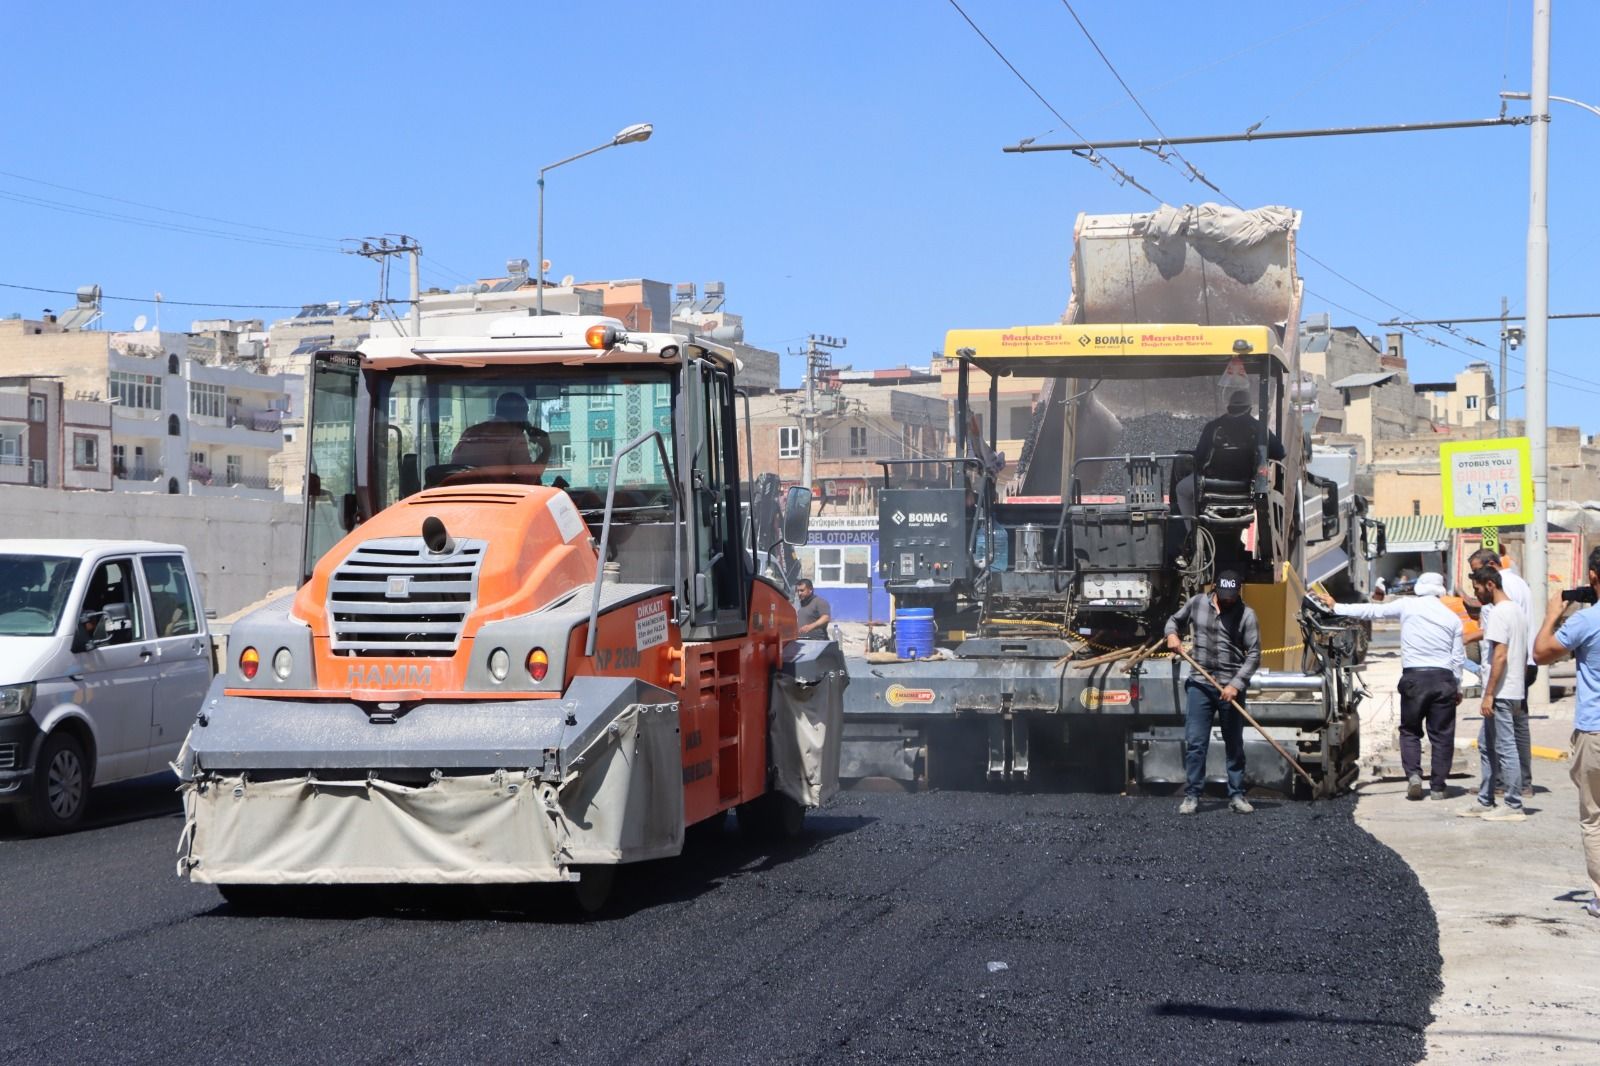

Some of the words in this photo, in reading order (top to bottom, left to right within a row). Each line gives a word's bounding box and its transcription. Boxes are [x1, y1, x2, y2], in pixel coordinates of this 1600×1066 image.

[1095, 336, 1134, 345] BOMAG
[908, 513, 948, 522] BOMAG
[827, 532, 874, 543] OTOPARK
[1220, 578, 1236, 588] KING
[348, 664, 432, 685] HAMM
